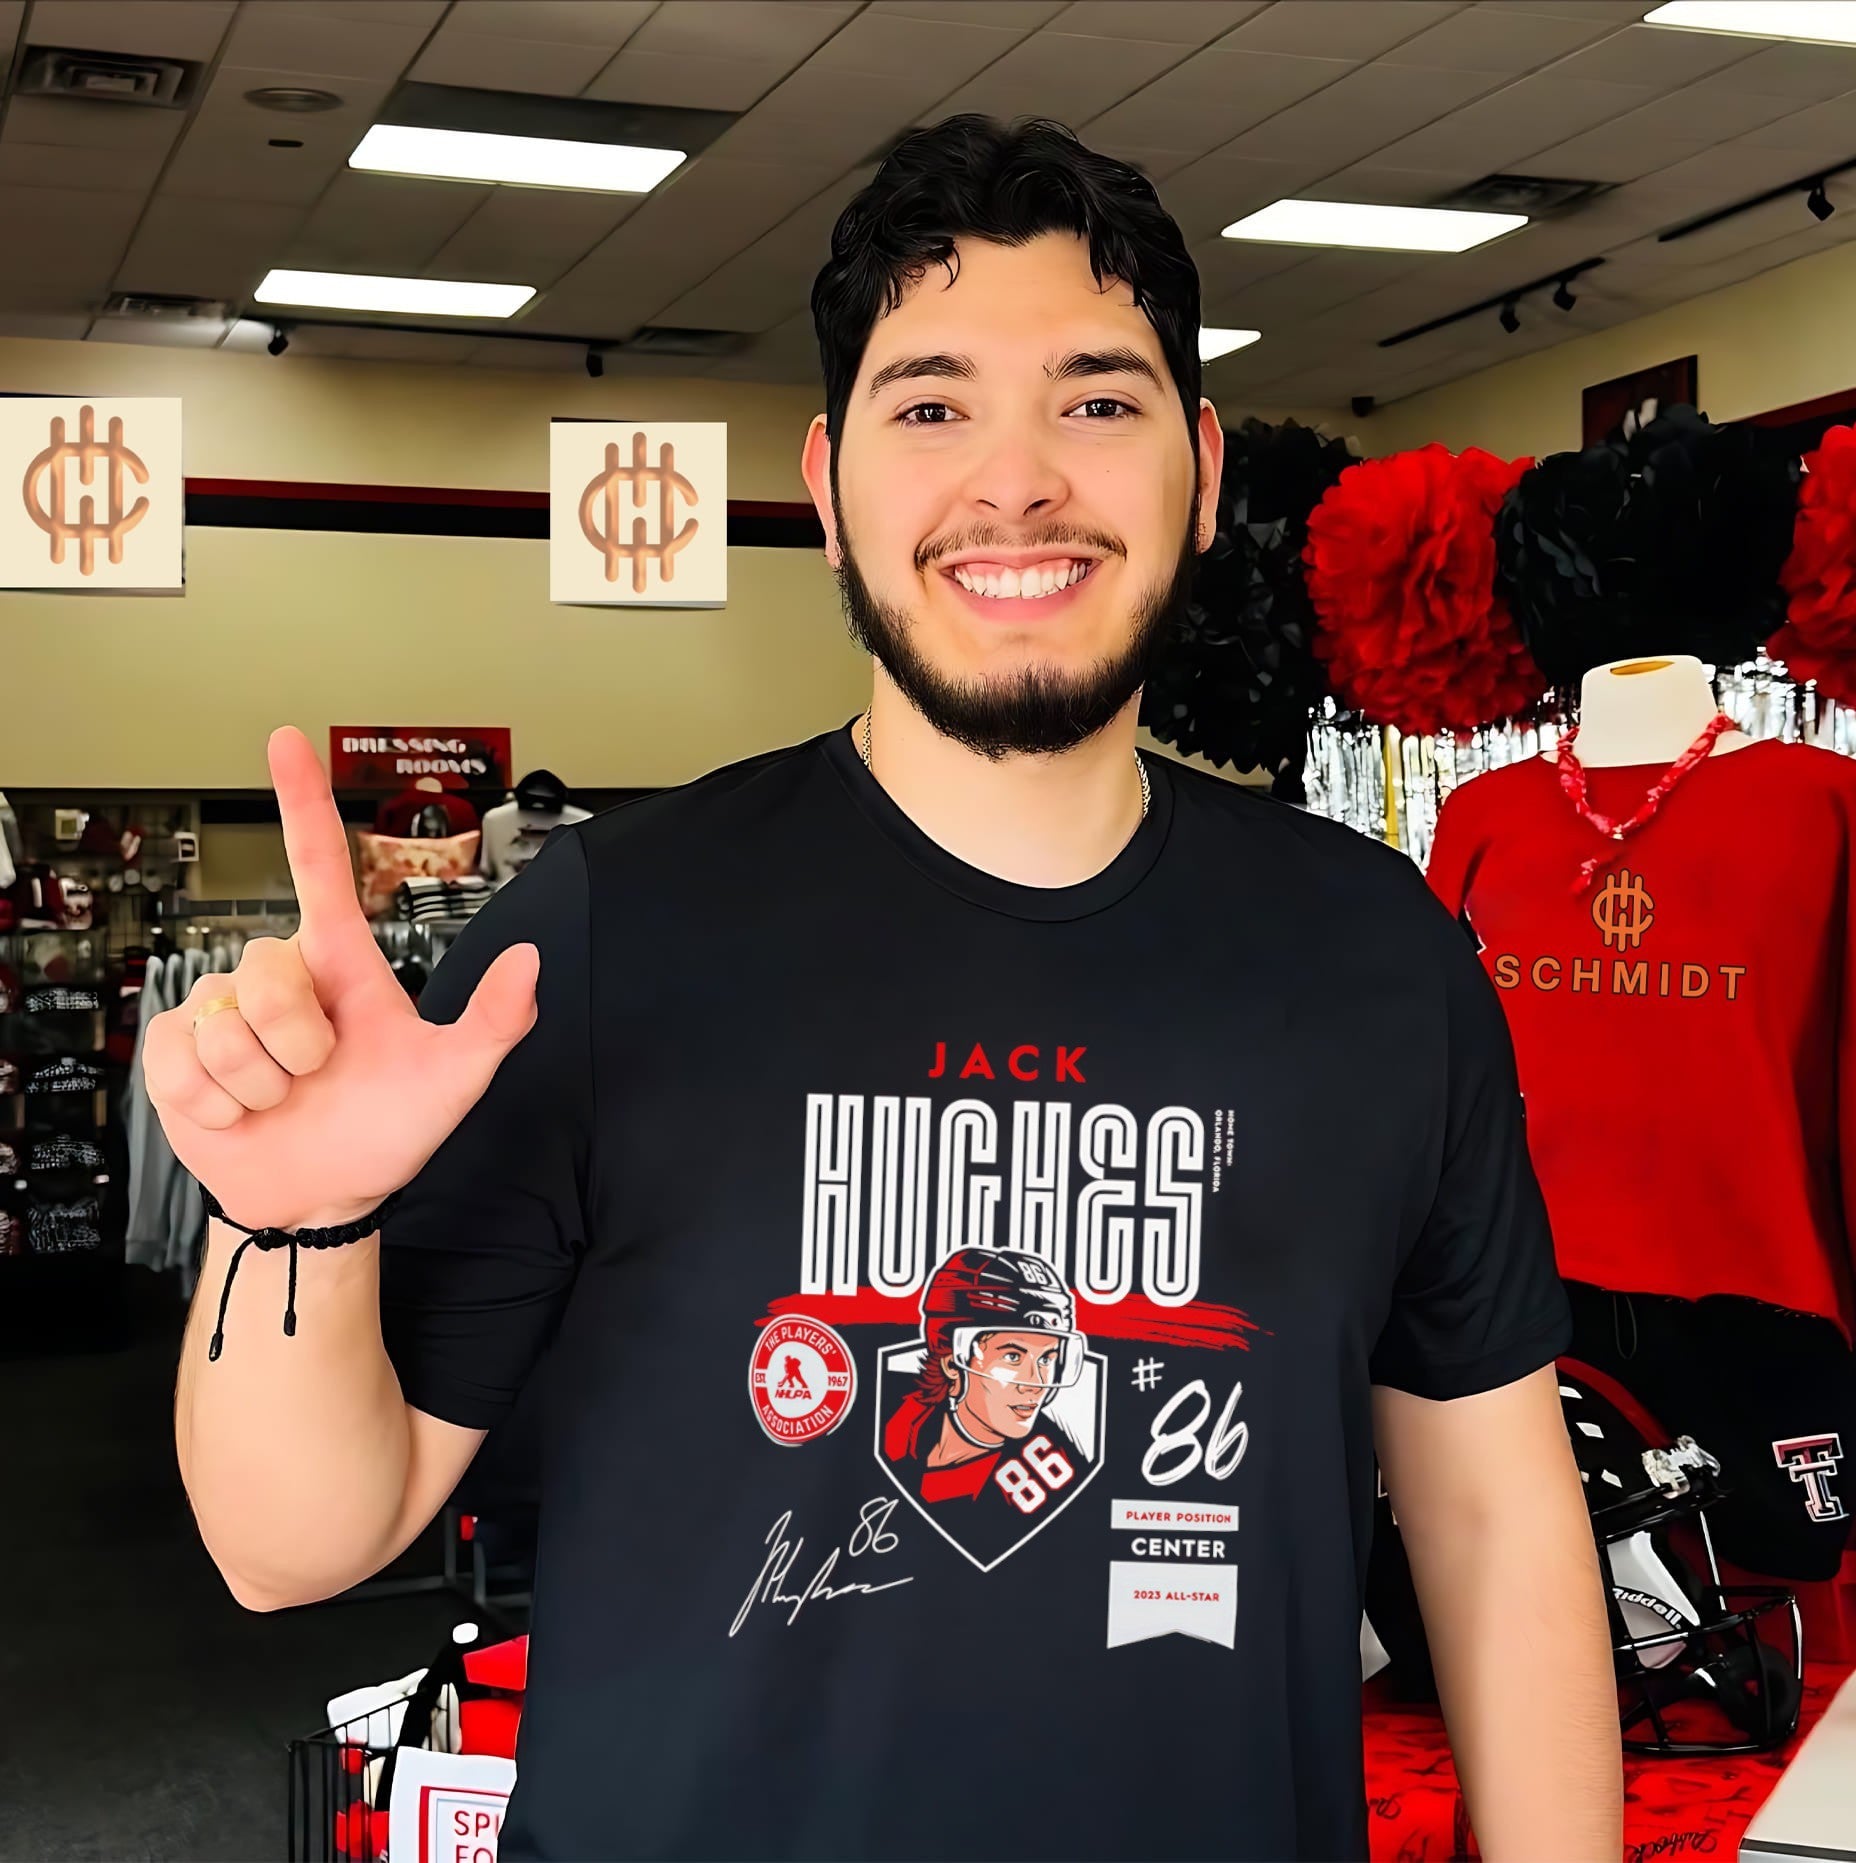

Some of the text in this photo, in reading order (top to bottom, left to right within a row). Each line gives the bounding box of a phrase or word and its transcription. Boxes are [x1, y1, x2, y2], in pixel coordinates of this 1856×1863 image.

[342, 737, 467, 754] DRESSING
[396, 758, 487, 775] ROOMS
[1494, 954, 1747, 1001] SCHMIDT
[928, 1042, 1088, 1084] JACK
[1211, 1155, 1222, 1194] FLORIDA
[800, 1093, 1205, 1308] HUGHES
[1016, 1260, 1049, 1286] 86
[765, 1332, 780, 1351] THE
[827, 1376, 848, 1388] 1967
[774, 1389, 813, 1400] NHLPA
[762, 1404, 835, 1435] ASSOCIATION
[994, 1434, 1075, 1515] 86
[1126, 1510, 1232, 1524] PLAYER POSITION
[1131, 1537, 1226, 1559] CENTER
[1133, 1589, 1221, 1603] 2023 ALL-STAR
